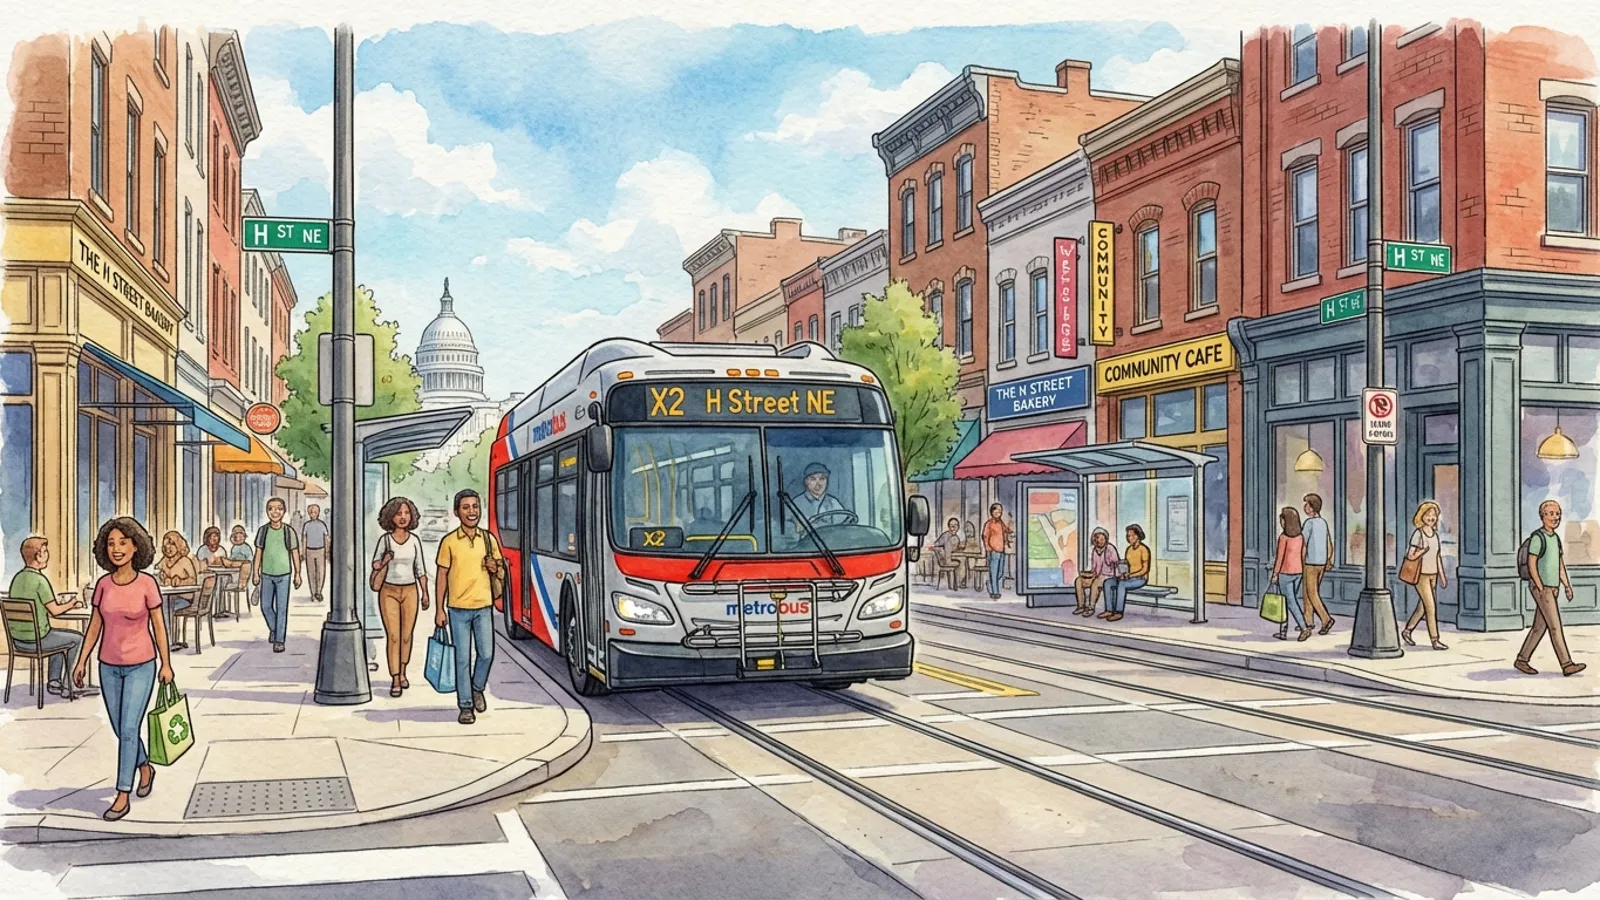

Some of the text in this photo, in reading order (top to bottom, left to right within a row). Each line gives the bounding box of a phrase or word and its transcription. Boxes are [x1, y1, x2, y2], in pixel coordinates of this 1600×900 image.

[254, 223, 322, 246] H ST NE
[79, 239, 100, 275] THE
[1394, 247, 1445, 267] H ST NE
[1097, 228, 1109, 337] COMMUNITY
[1326, 300, 1335, 319] H
[1104, 343, 1223, 383] COMMUNITY CAFE
[996, 386, 1016, 400] THE
[1030, 376, 1073, 395] STREET
[650, 387, 836, 416] X2 H Street NE
[1013, 394, 1056, 412] BAKERY
[643, 530, 666, 547] X2
